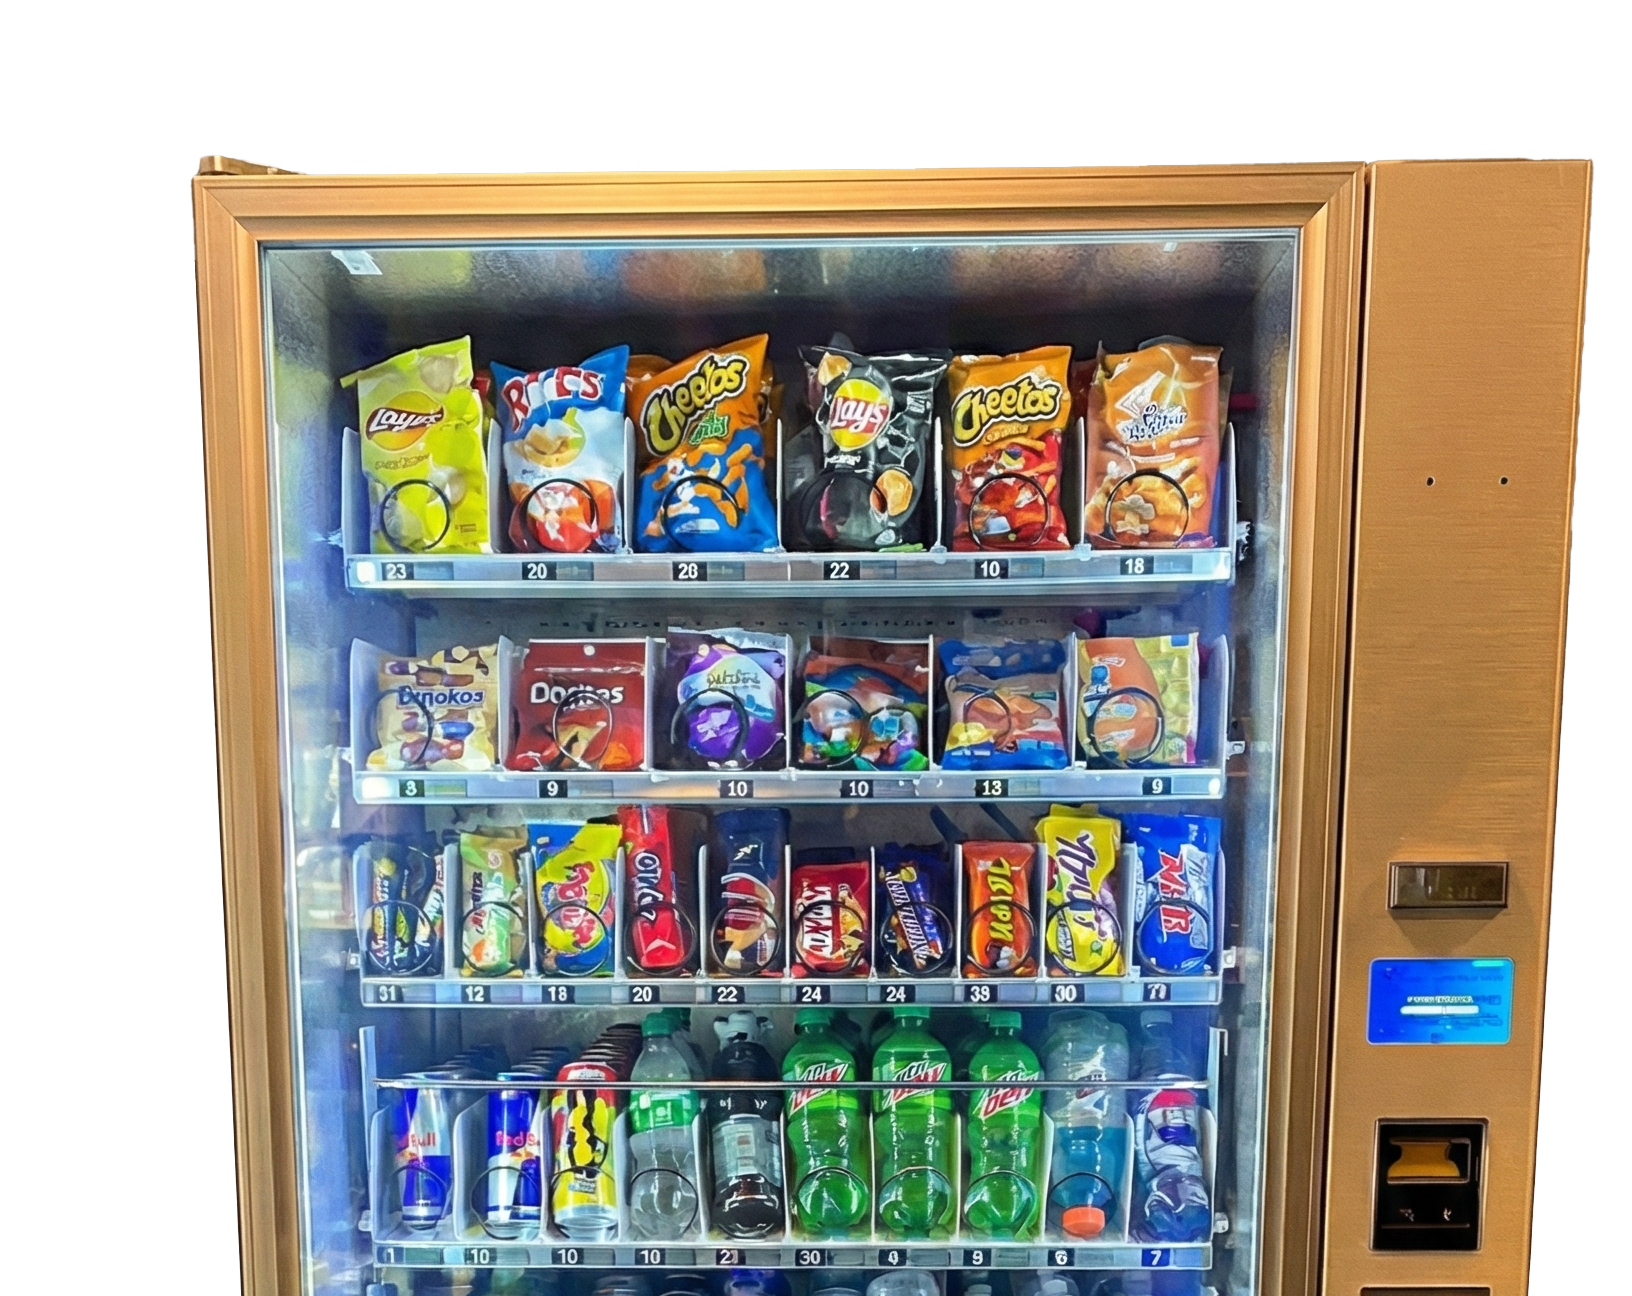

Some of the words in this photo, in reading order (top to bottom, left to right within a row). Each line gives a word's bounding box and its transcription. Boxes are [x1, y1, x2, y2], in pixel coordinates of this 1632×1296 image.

[642, 353, 749, 458] Cheetos
[952, 373, 1062, 447] Cheetos
[386, 563, 407, 579] 23
[527, 563, 547, 579] 20
[830, 562, 849, 579] 22
[980, 561, 1000, 577] 10
[1125, 557, 1145, 574] 18
[547, 781, 558, 796] 9
[728, 781, 748, 796] 10
[849, 781, 869, 796] 10
[982, 780, 1002, 795] 13
[465, 986, 484, 1002] 12
[548, 986, 567, 1001] 18
[632, 987, 652, 1002] 20
[717, 987, 737, 1002] 22
[802, 986, 822, 1002] 24
[886, 986, 906, 1002] 24
[388, 1248, 395, 1263] 1
[471, 1249, 490, 1264] 10
[557, 1249, 578, 1264] 10
[640, 1249, 660, 1264] 10
[799, 1250, 821, 1265] 30
[1150, 1250, 1162, 1265] 7
